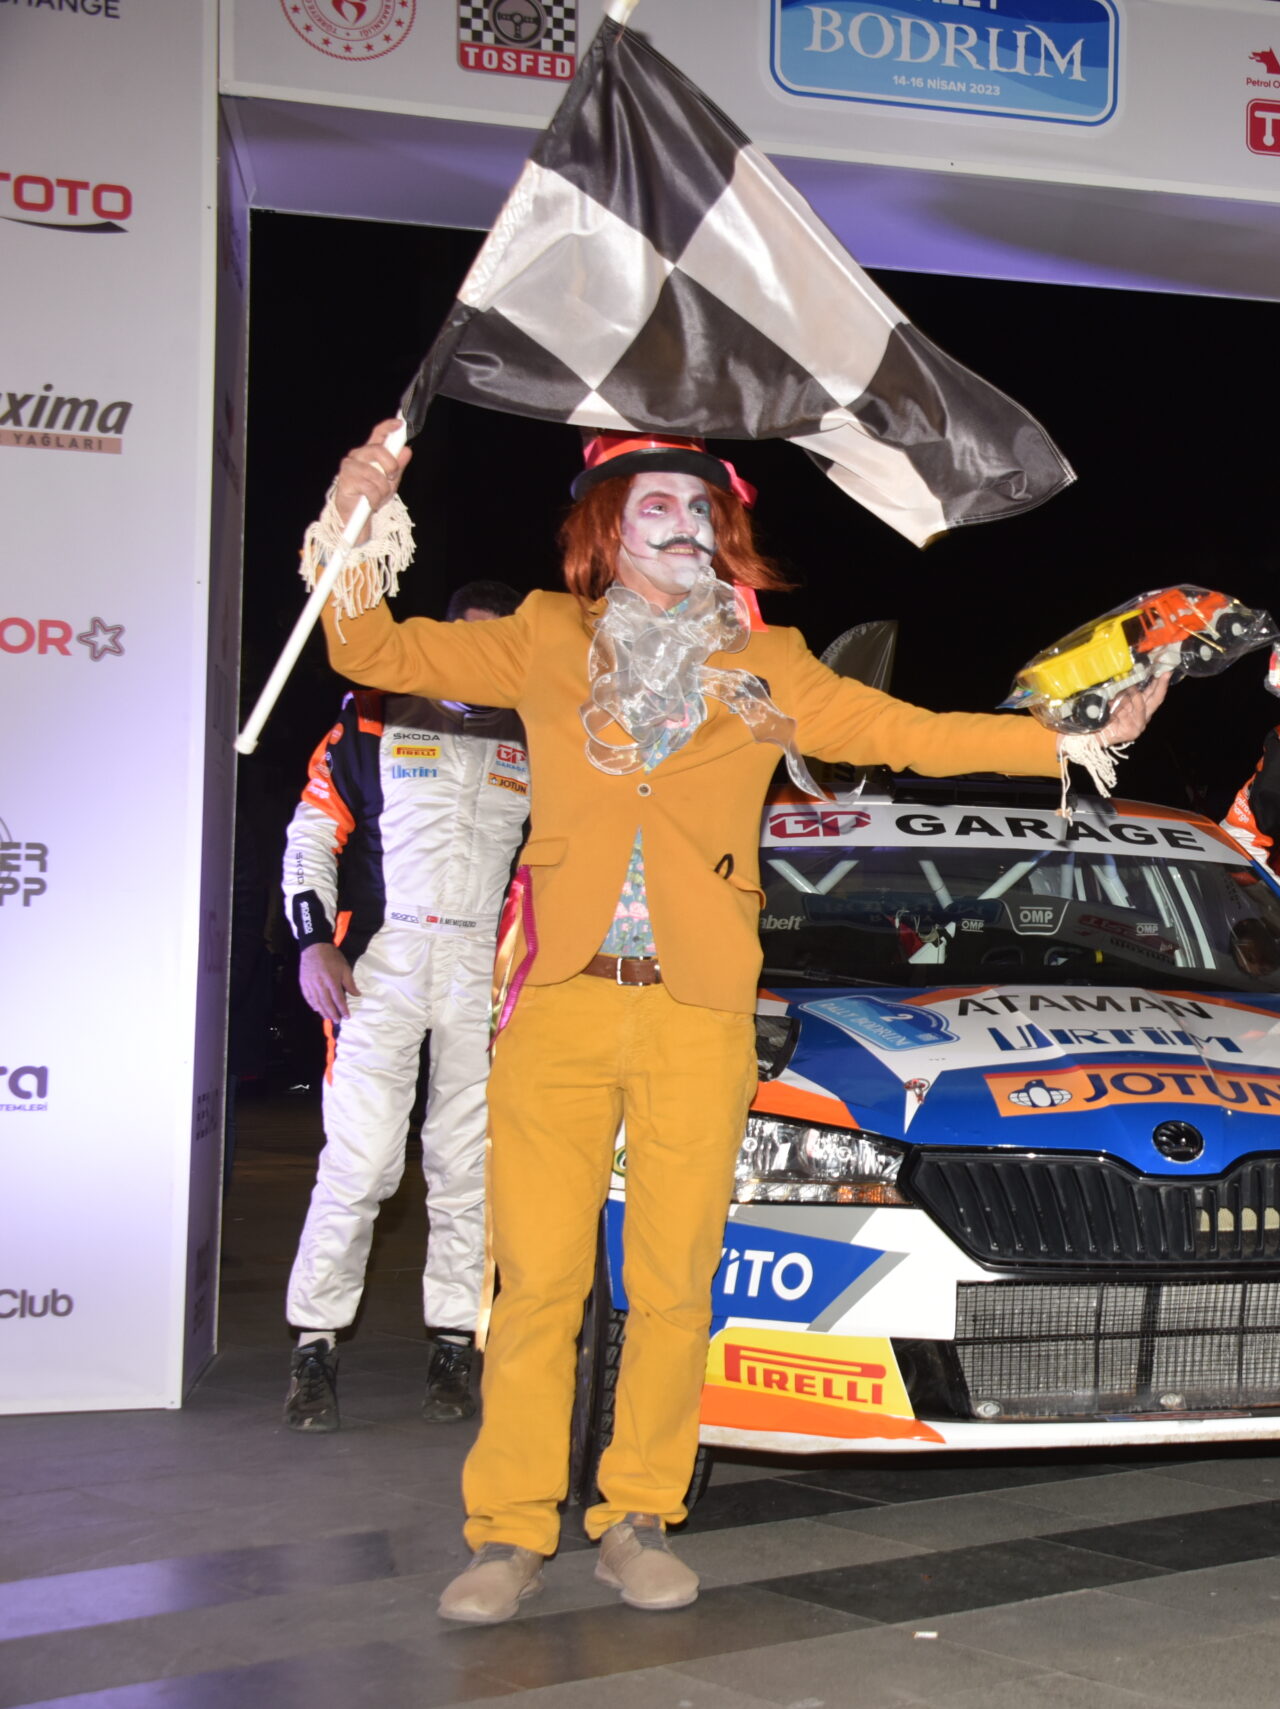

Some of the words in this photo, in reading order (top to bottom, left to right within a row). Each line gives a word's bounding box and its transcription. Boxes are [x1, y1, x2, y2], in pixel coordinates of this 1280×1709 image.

[804, 5, 1088, 82] BODRUM
[463, 46, 572, 79] TOSFED
[892, 75, 924, 88] 14-16
[927, 77, 967, 92] NİSAN
[969, 82, 1001, 96] 2023
[1246, 77, 1271, 88] Petrol
[0, 383, 133, 435] xima
[13, 432, 103, 450] YAĞLARI
[396, 746, 437, 757] PIRELLI
[499, 779, 527, 794] JOTUN
[895, 813, 1206, 852] GARAGE
[961, 920, 984, 931] OMP
[1020, 910, 1053, 924] OMP
[1136, 924, 1159, 935] OMP
[957, 993, 1215, 1020] ATAMAN
[819, 1002, 857, 1019] RALLY
[854, 1015, 911, 1046] BODRUM
[880, 1013, 914, 1023] 2
[723, 1342, 887, 1406] PIRELLI
